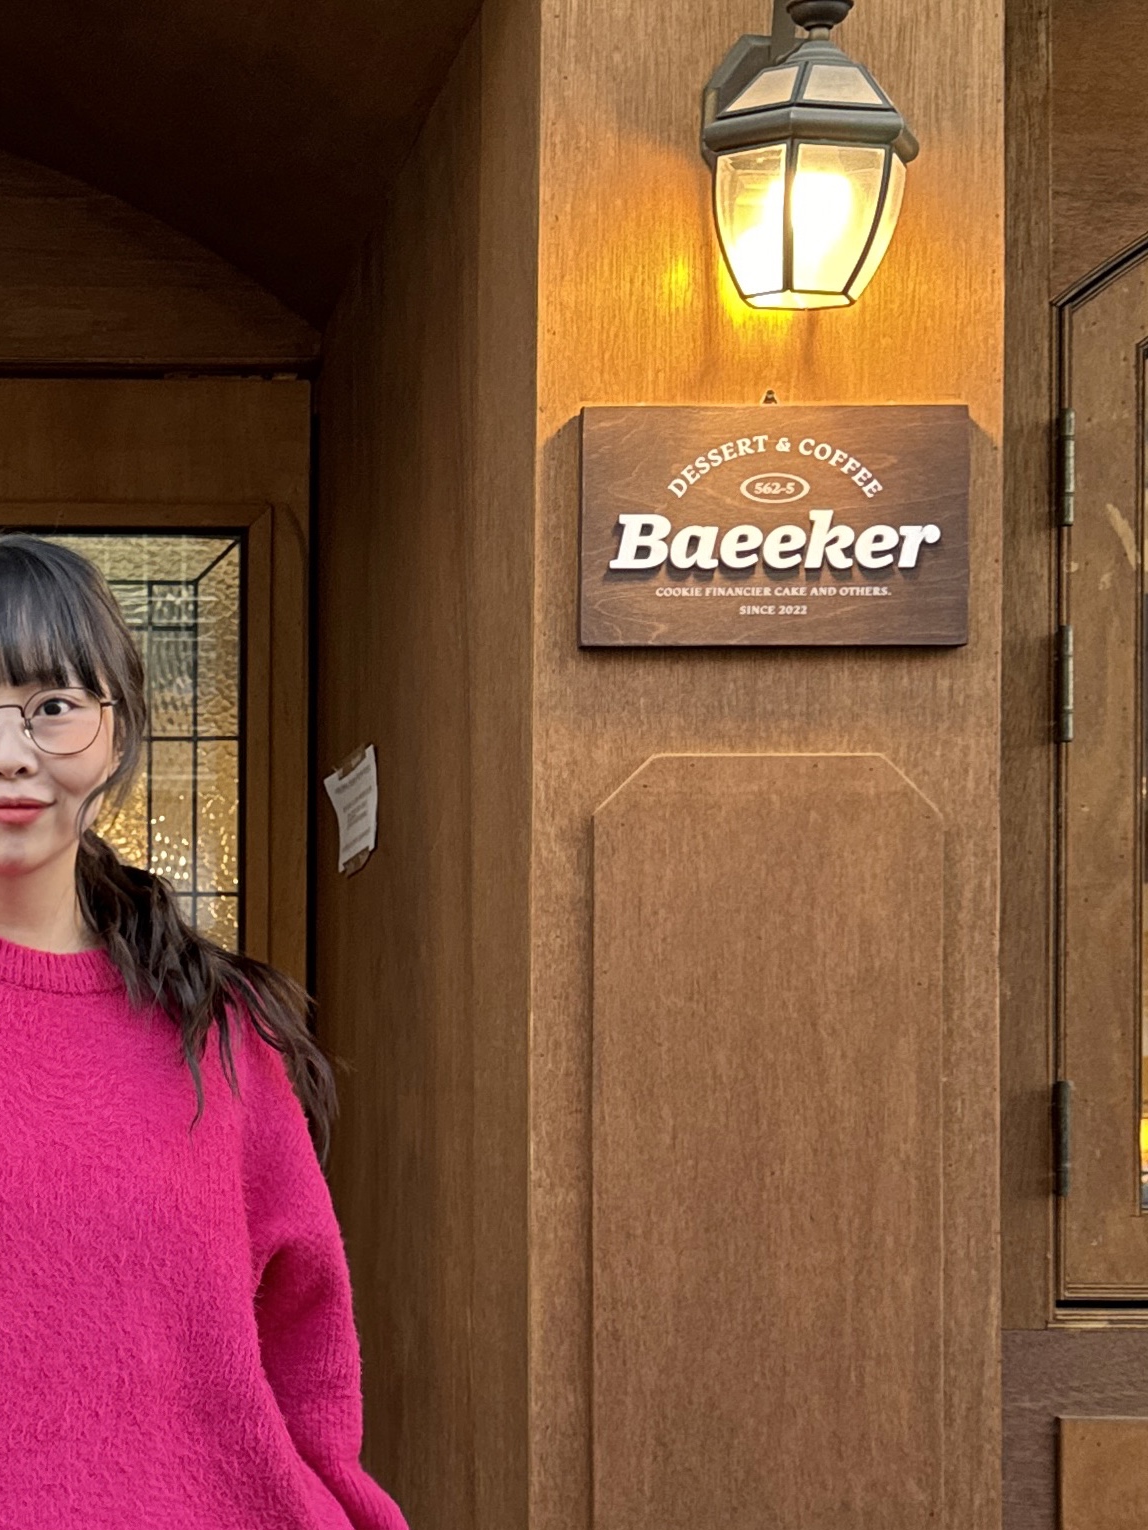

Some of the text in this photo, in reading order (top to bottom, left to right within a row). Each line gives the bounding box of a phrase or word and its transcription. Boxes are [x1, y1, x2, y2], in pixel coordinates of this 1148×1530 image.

[667, 435, 884, 499] DESSERT & COFFEE
[754, 482, 796, 495] 562-5
[608, 508, 942, 570] Baeeker
[655, 586, 892, 598] COOKIE FINANCIER CAKE AND OTHERS.
[739, 604, 808, 616] SINCE 2022
